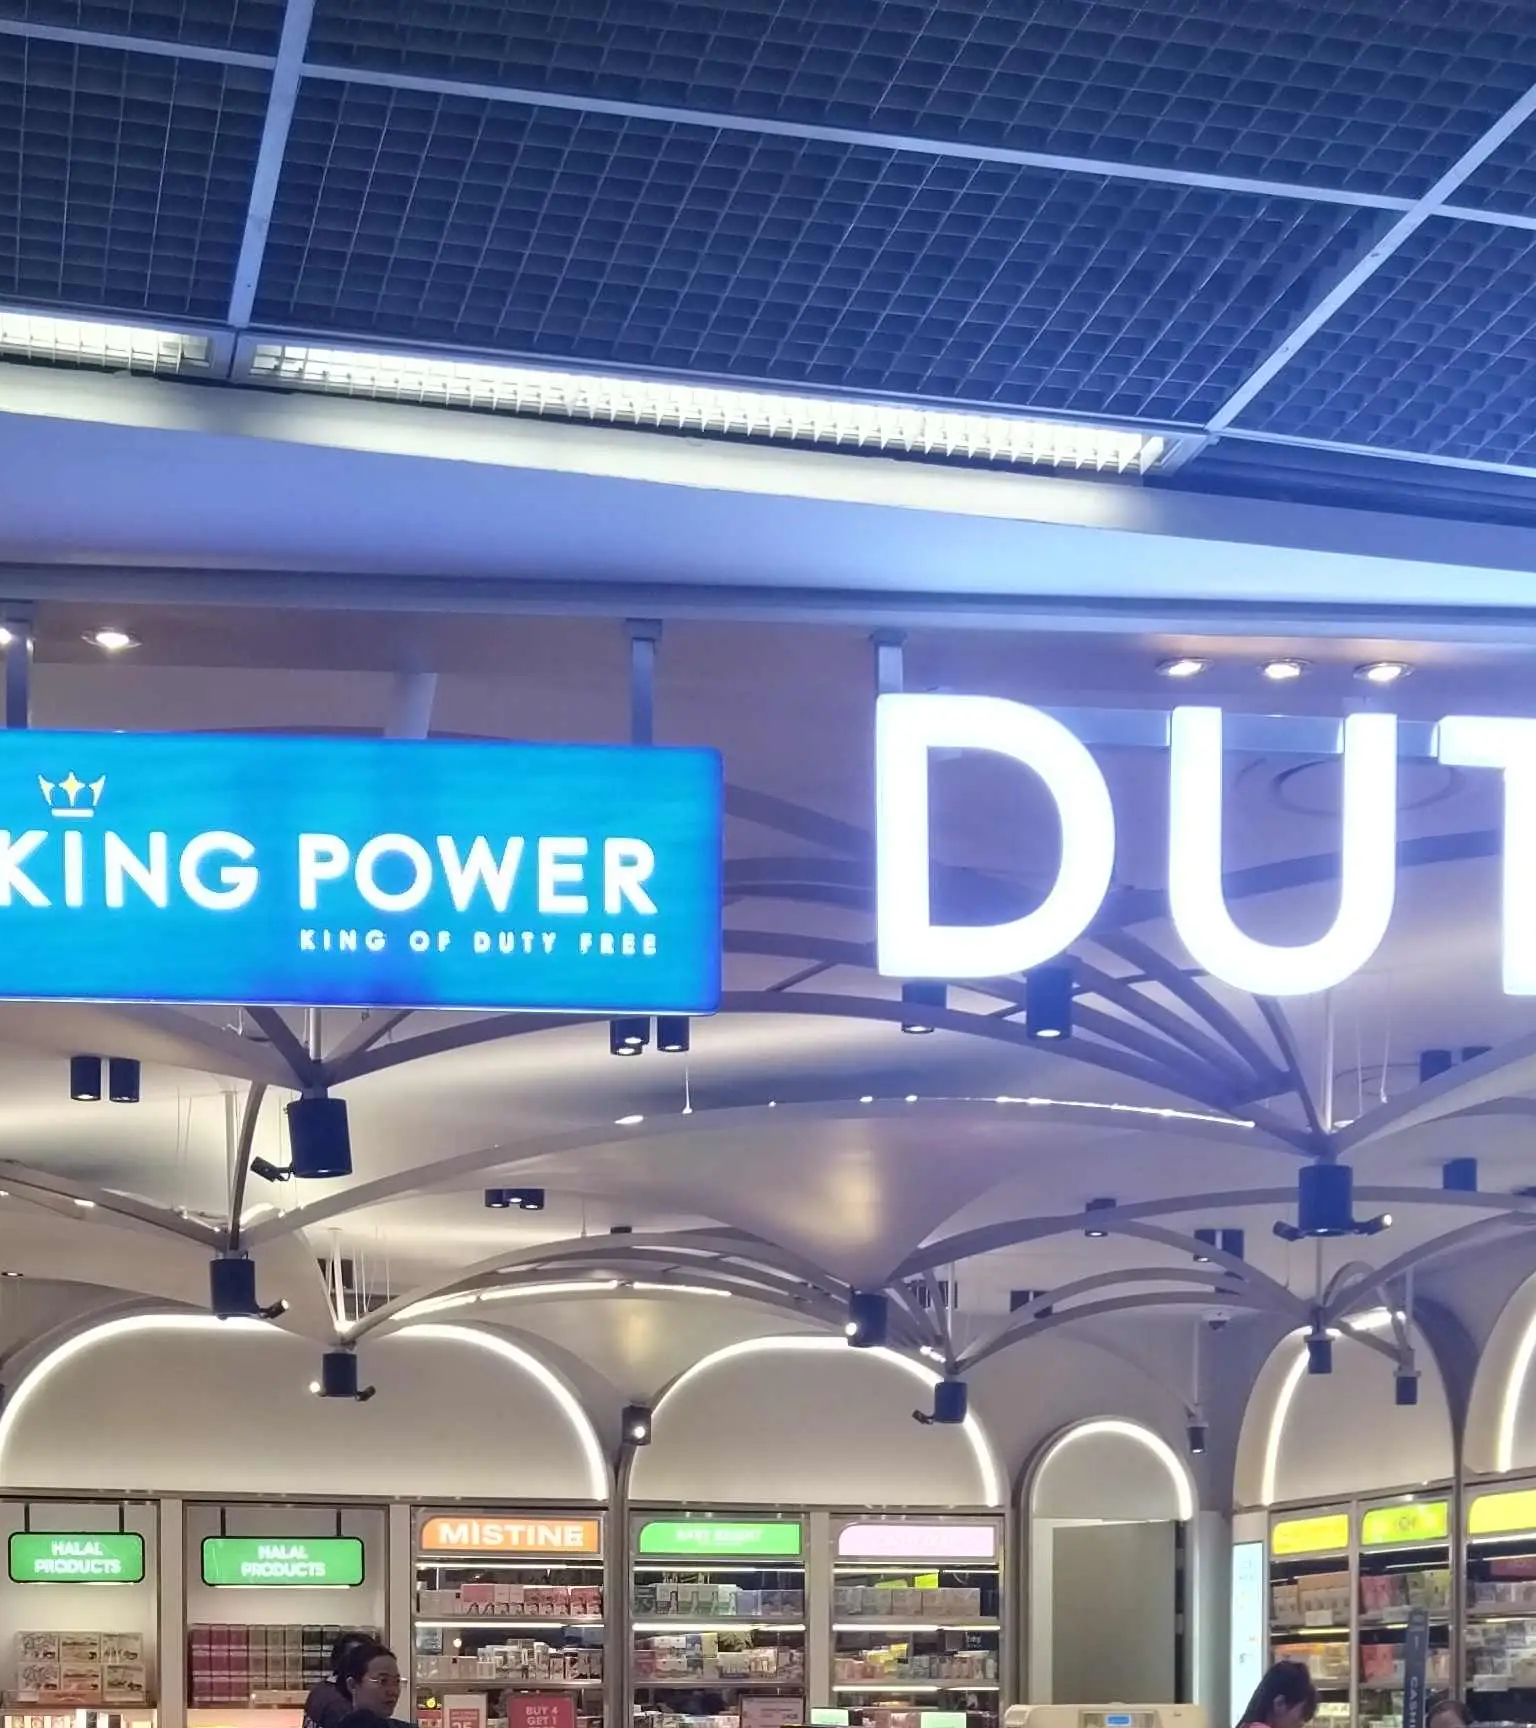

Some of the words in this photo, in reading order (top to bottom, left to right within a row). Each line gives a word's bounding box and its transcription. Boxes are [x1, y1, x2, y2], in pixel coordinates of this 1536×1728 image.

[298, 832, 659, 915] POWER
[300, 928, 387, 952] KING
[409, 929, 450, 953] OF
[473, 931, 557, 955] DUTY
[580, 932, 658, 957] FREE
[438, 1521, 584, 1547] MISTINE
[51, 1540, 103, 1556] HALAL
[258, 1545, 308, 1561] HALAL
[34, 1558, 121, 1575] PRODUCTS
[241, 1562, 326, 1578] PRODUCTS
[526, 1706, 547, 1715] BUY
[551, 1706, 559, 1715] 4
[527, 1717, 548, 1726] GET
